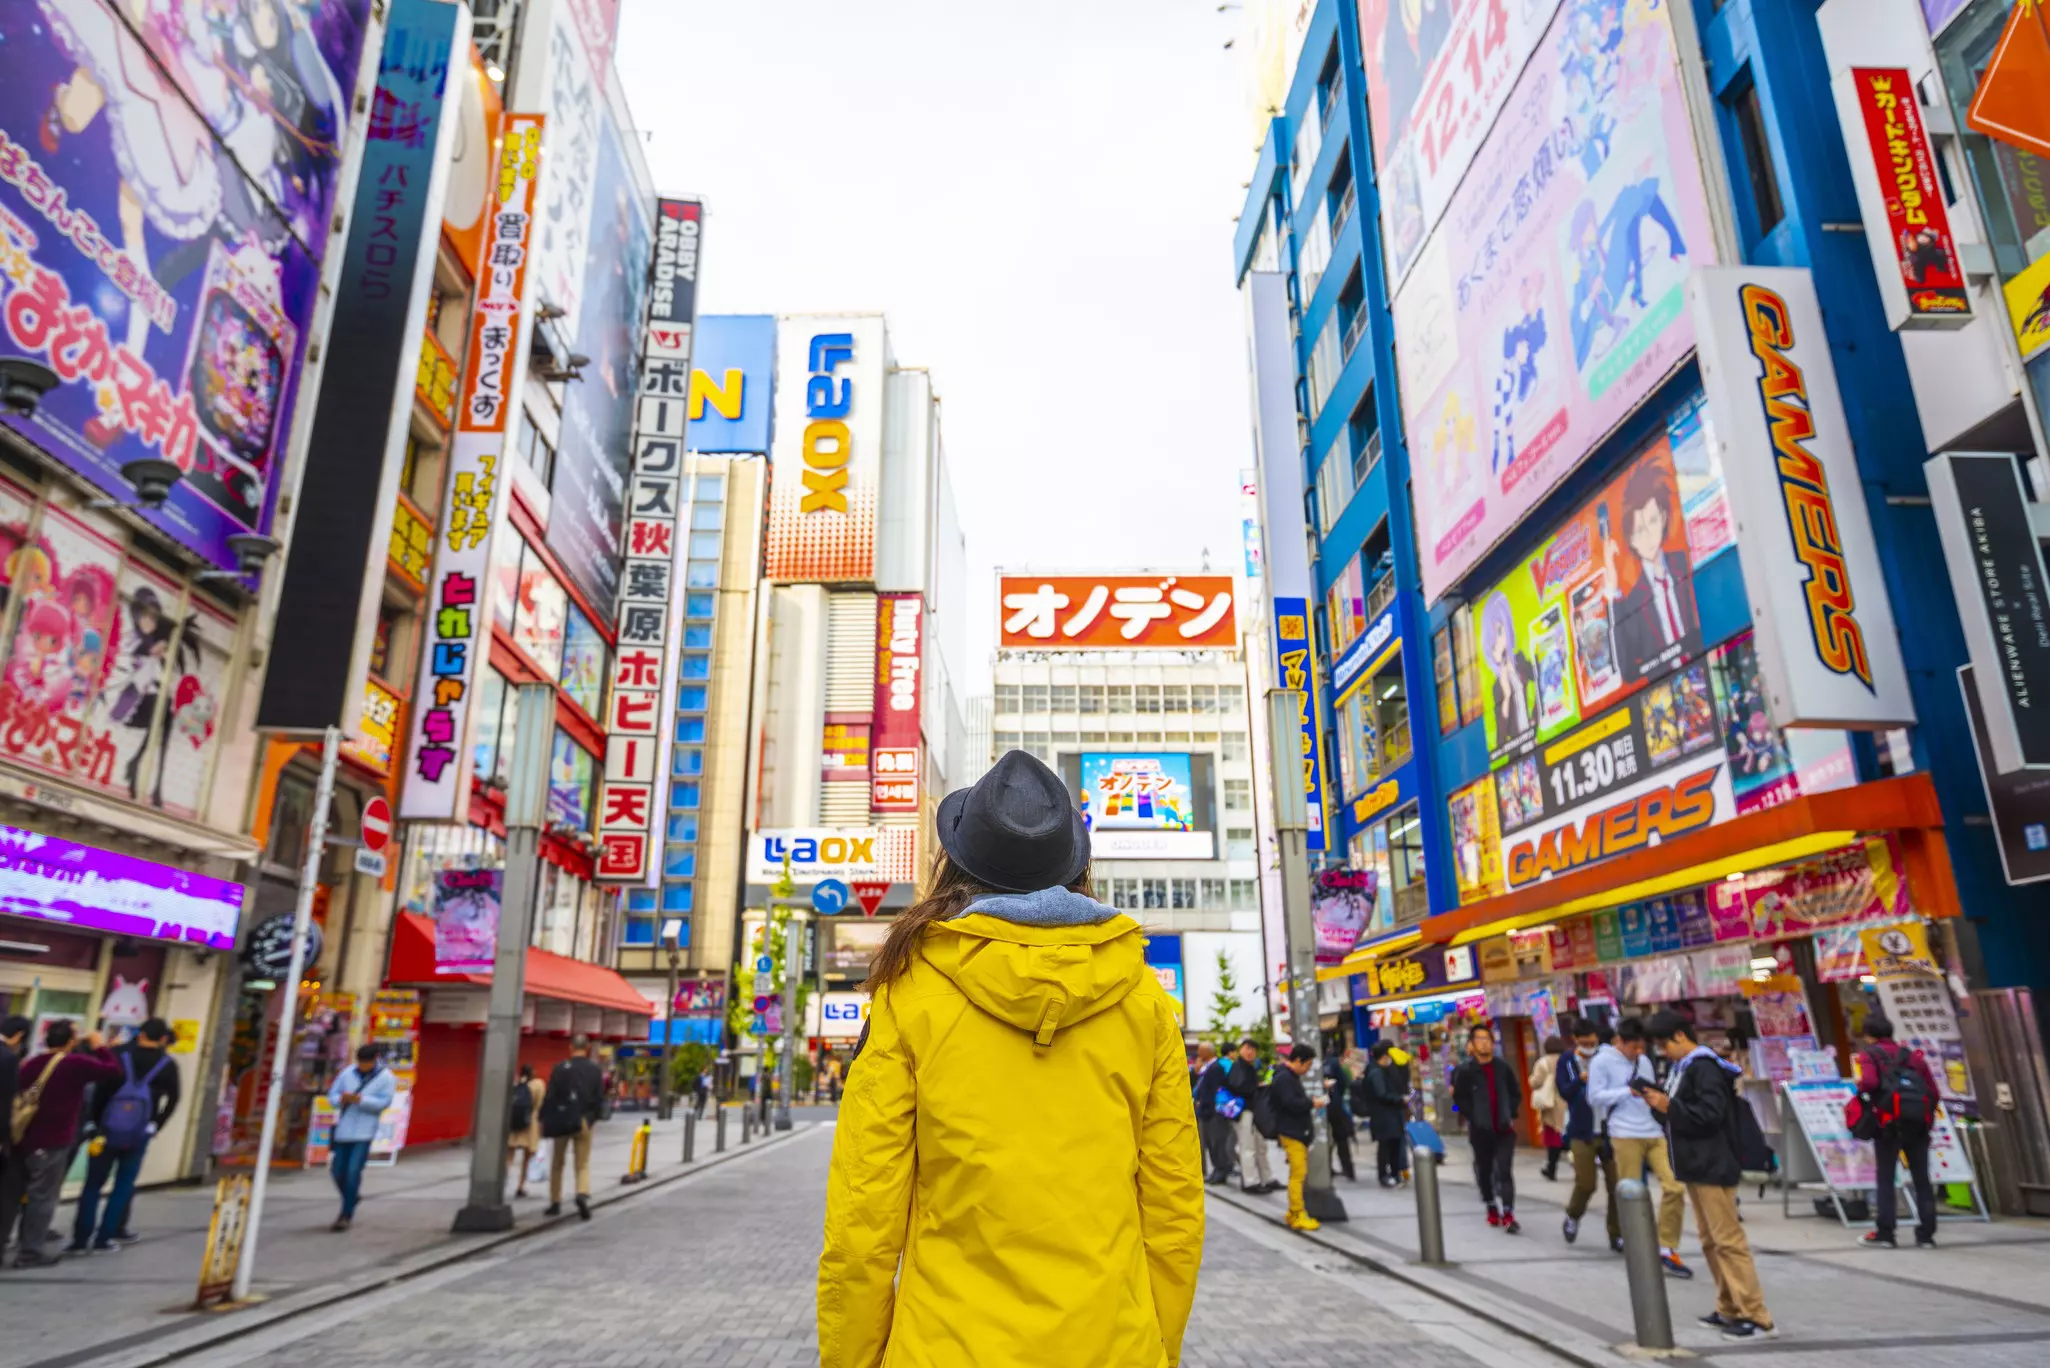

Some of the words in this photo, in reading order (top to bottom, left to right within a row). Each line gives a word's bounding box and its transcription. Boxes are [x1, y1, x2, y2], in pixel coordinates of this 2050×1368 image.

[651, 202, 680, 319] PARADISE
[675, 203, 700, 282] HOBBY
[1738, 283, 1877, 697] GAMERS
[1969, 506, 1992, 555] AKIBA
[1002, 576, 1232, 640] オノデン
[1982, 557, 2006, 610] STORE
[1996, 613, 2031, 709] ALIENWARE
[1549, 743, 1615, 807] 11.30
[1508, 763, 1722, 889] GAMERS
